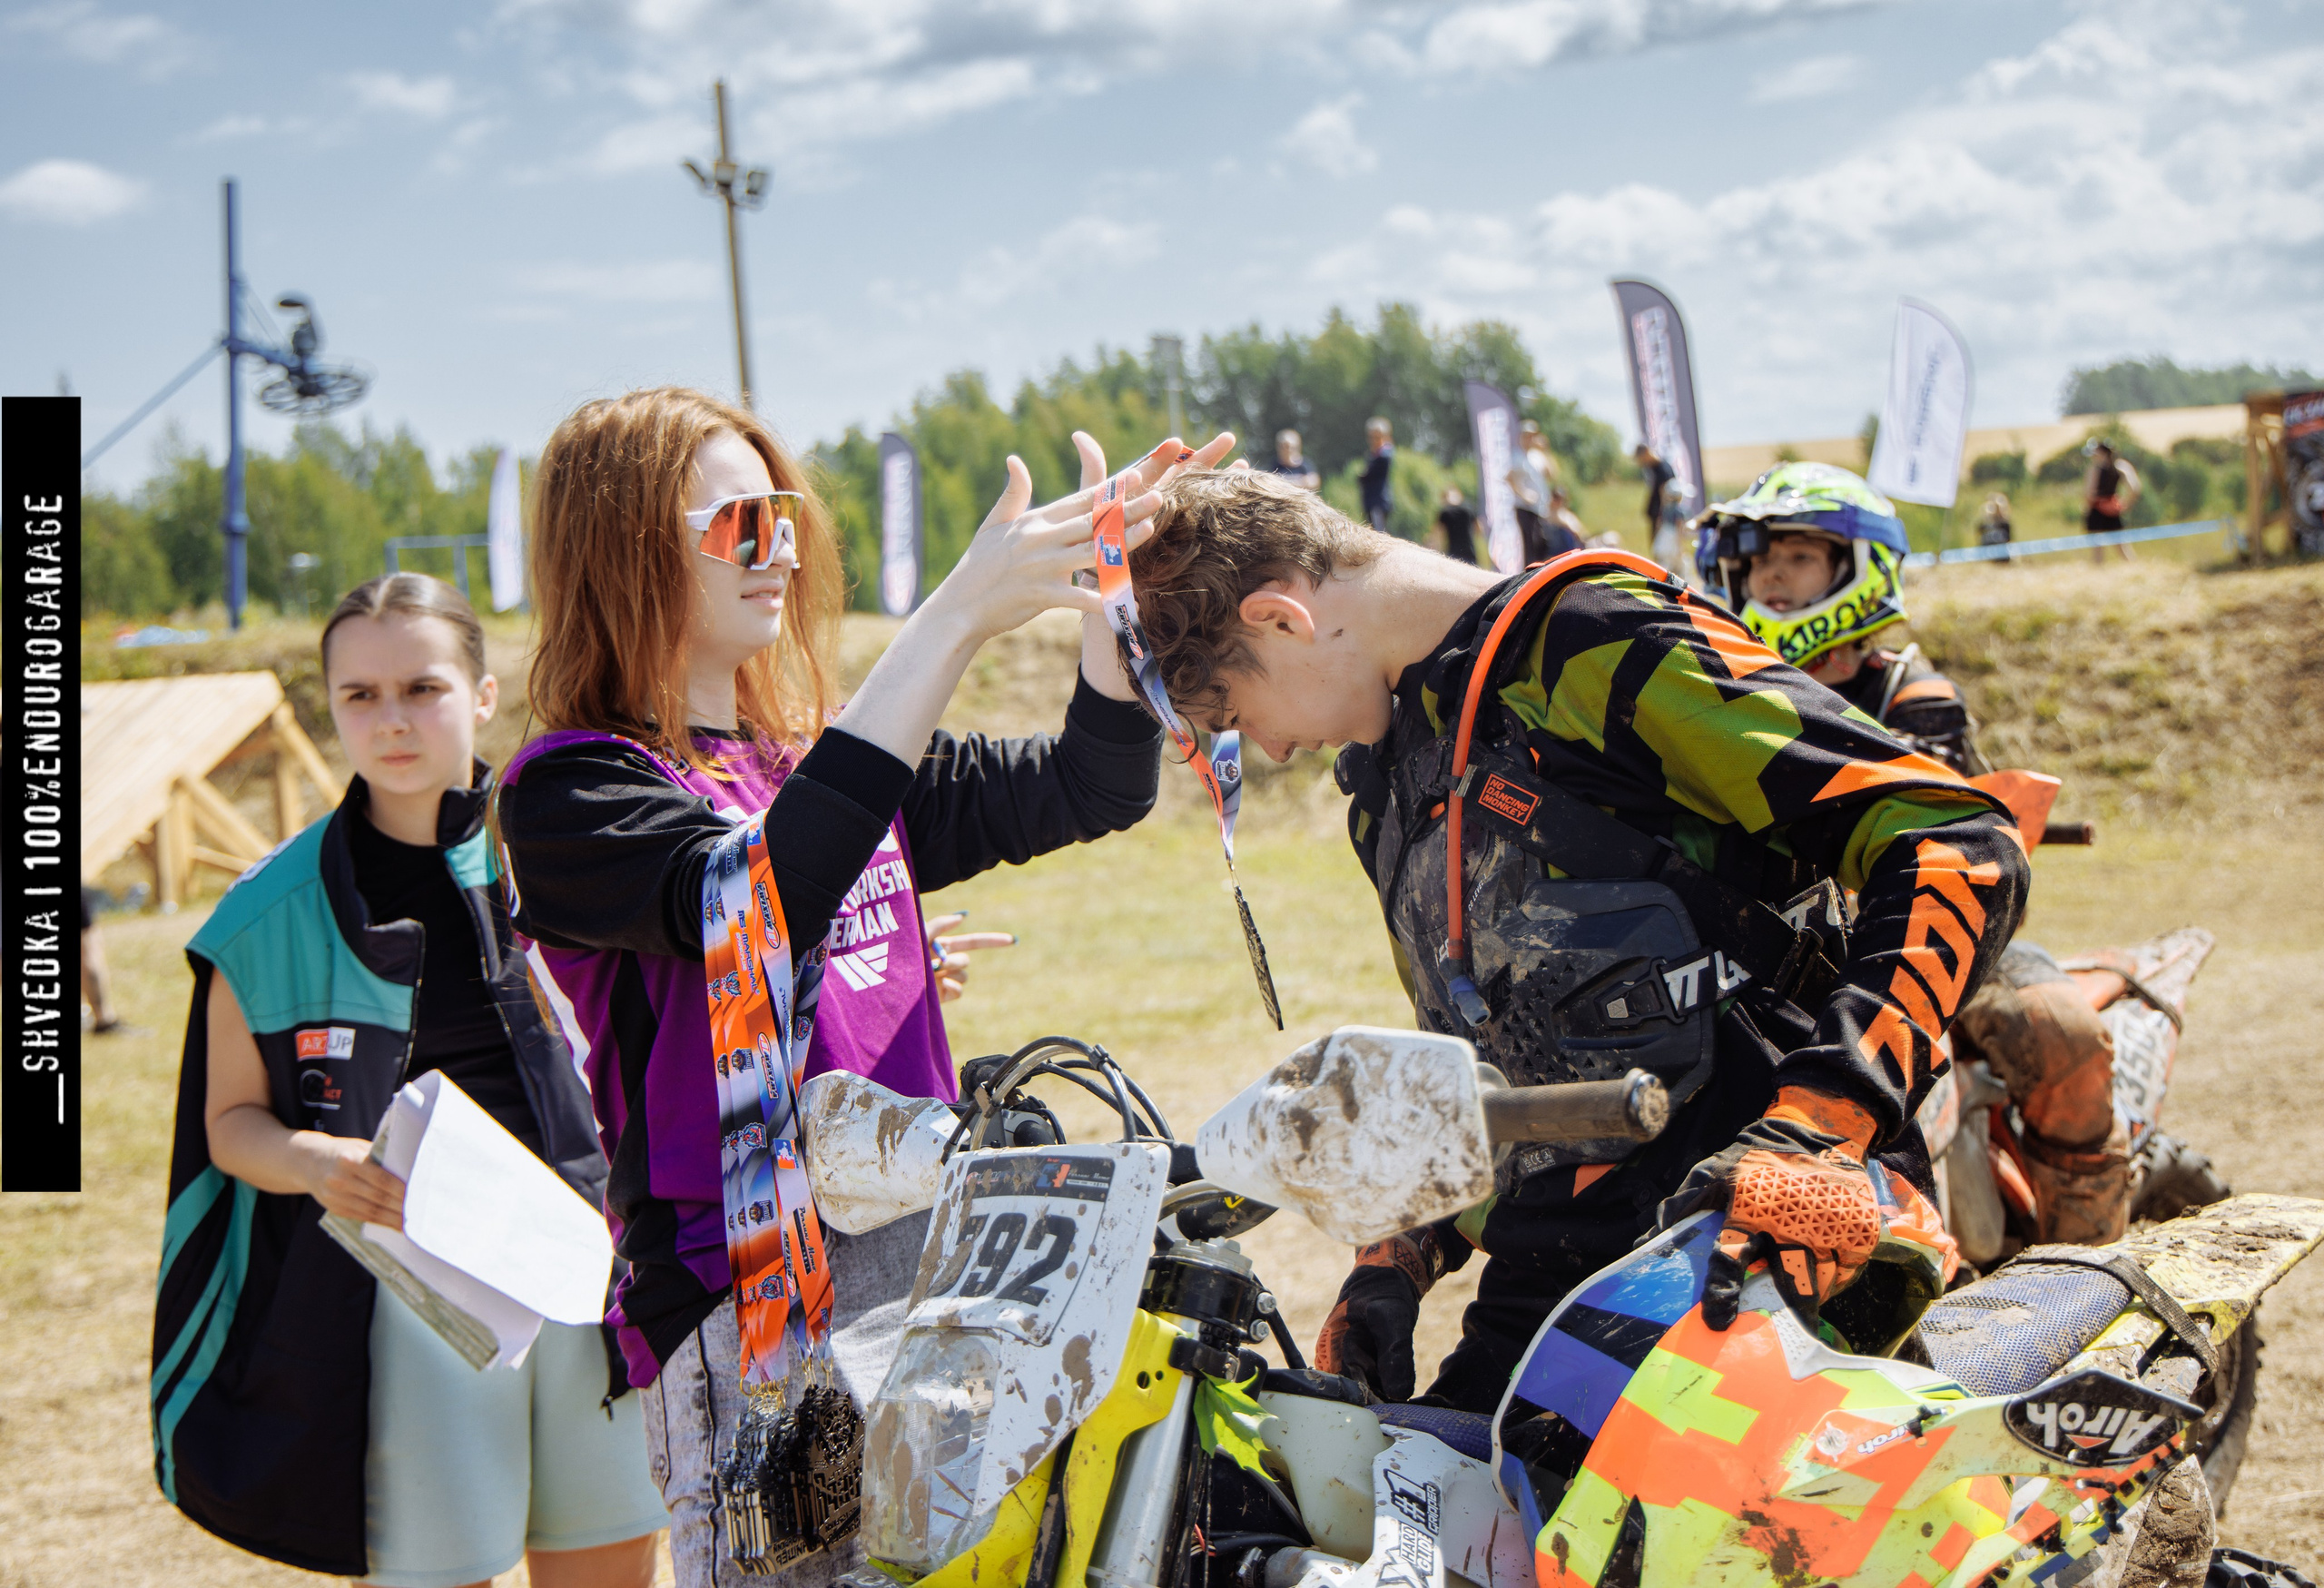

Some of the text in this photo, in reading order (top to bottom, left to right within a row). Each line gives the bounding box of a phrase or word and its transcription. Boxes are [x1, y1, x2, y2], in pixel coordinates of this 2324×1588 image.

[1486, 786, 1530, 812] DANCING
[1490, 779, 1505, 791] NO
[1482, 794, 1526, 818] MONKEY
[1857, 1424, 1910, 1454] iroh
[2026, 1402, 2166, 1455] Airoh
[1401, 1525, 1415, 1563] HARD
[1416, 1534, 1434, 1573] GLIDE
